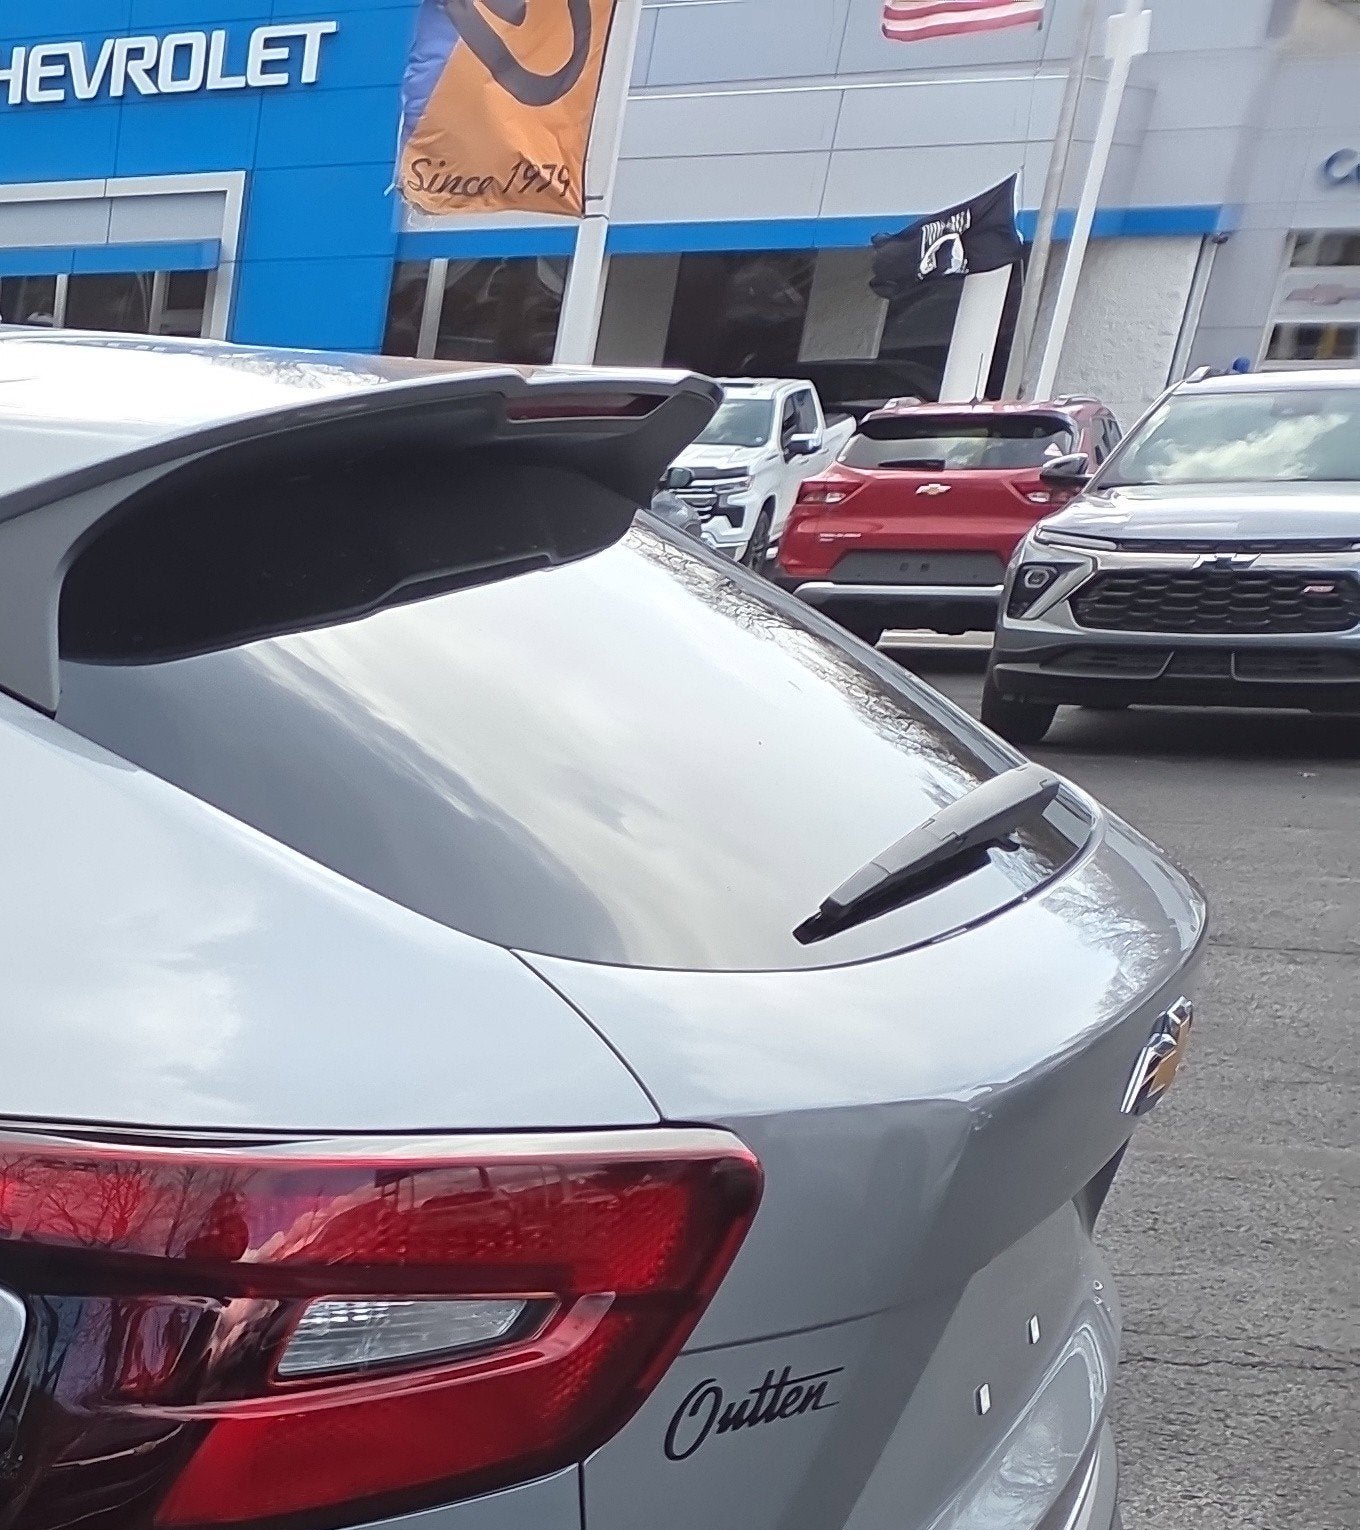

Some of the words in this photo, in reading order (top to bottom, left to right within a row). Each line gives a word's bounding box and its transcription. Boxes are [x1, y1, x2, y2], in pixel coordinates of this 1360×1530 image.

[407, 157, 493, 197] Since
[501, 157, 571, 198] 1979
[663, 1365, 846, 1461] Outten
